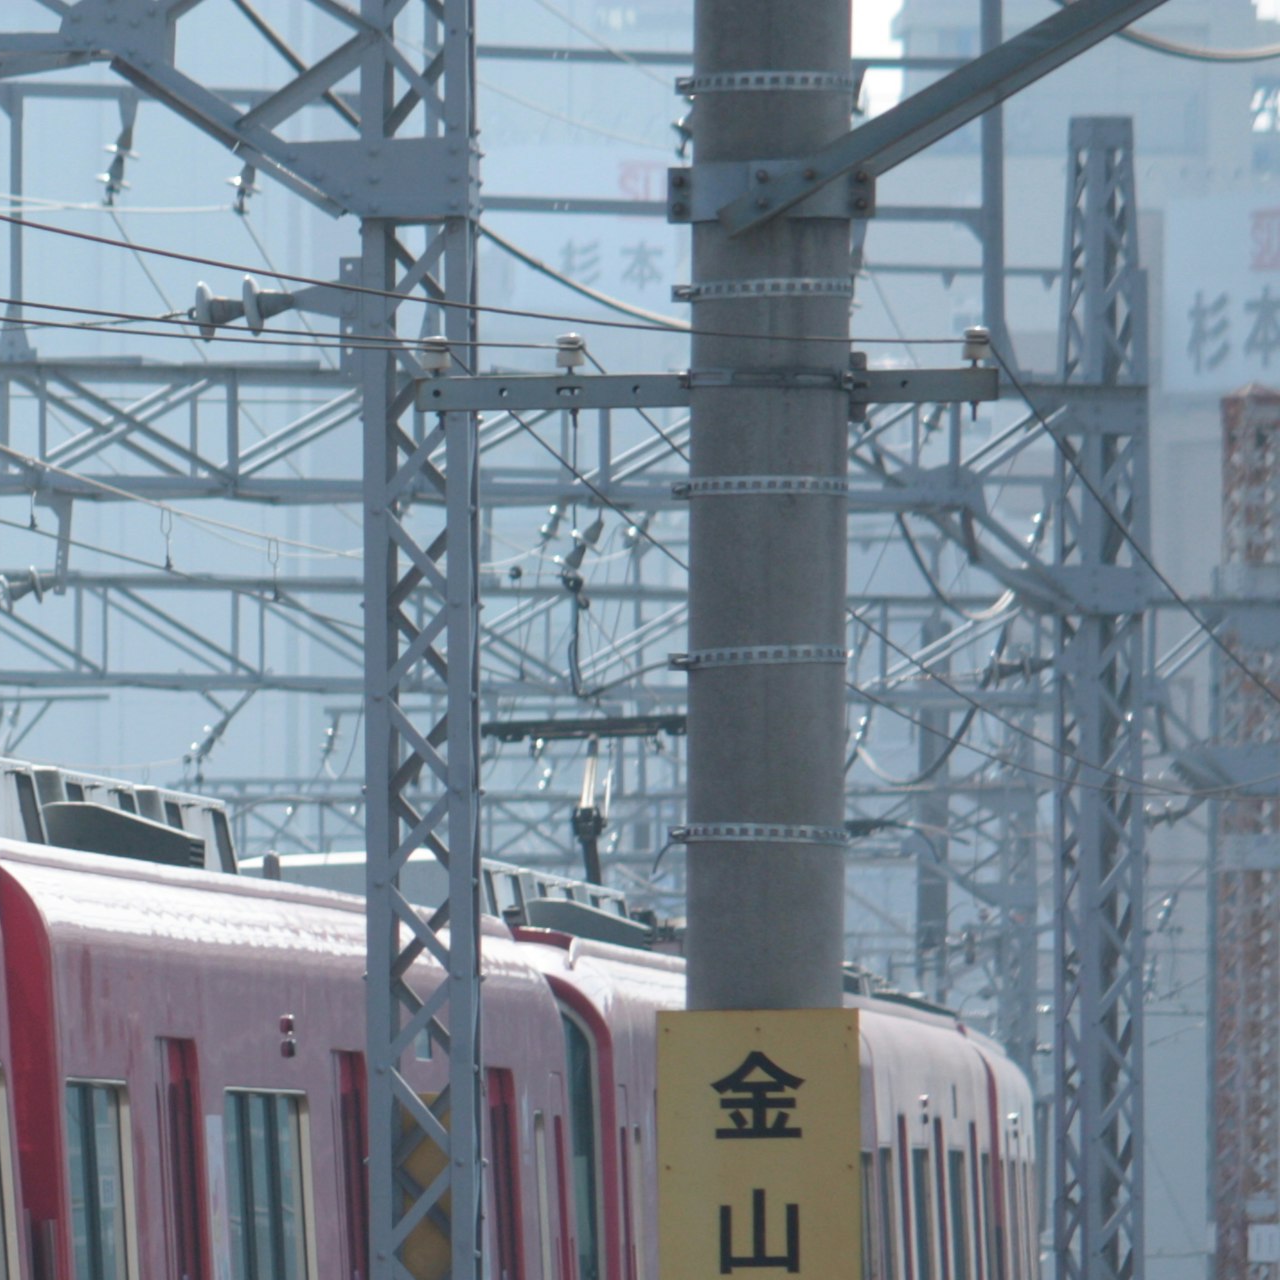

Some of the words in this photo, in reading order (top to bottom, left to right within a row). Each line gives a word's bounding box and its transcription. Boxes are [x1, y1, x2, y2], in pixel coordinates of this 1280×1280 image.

[558, 238, 664, 292] 杉本
[1187, 284, 1280, 375] 杉本
[710, 1051, 806, 1274] 金山
